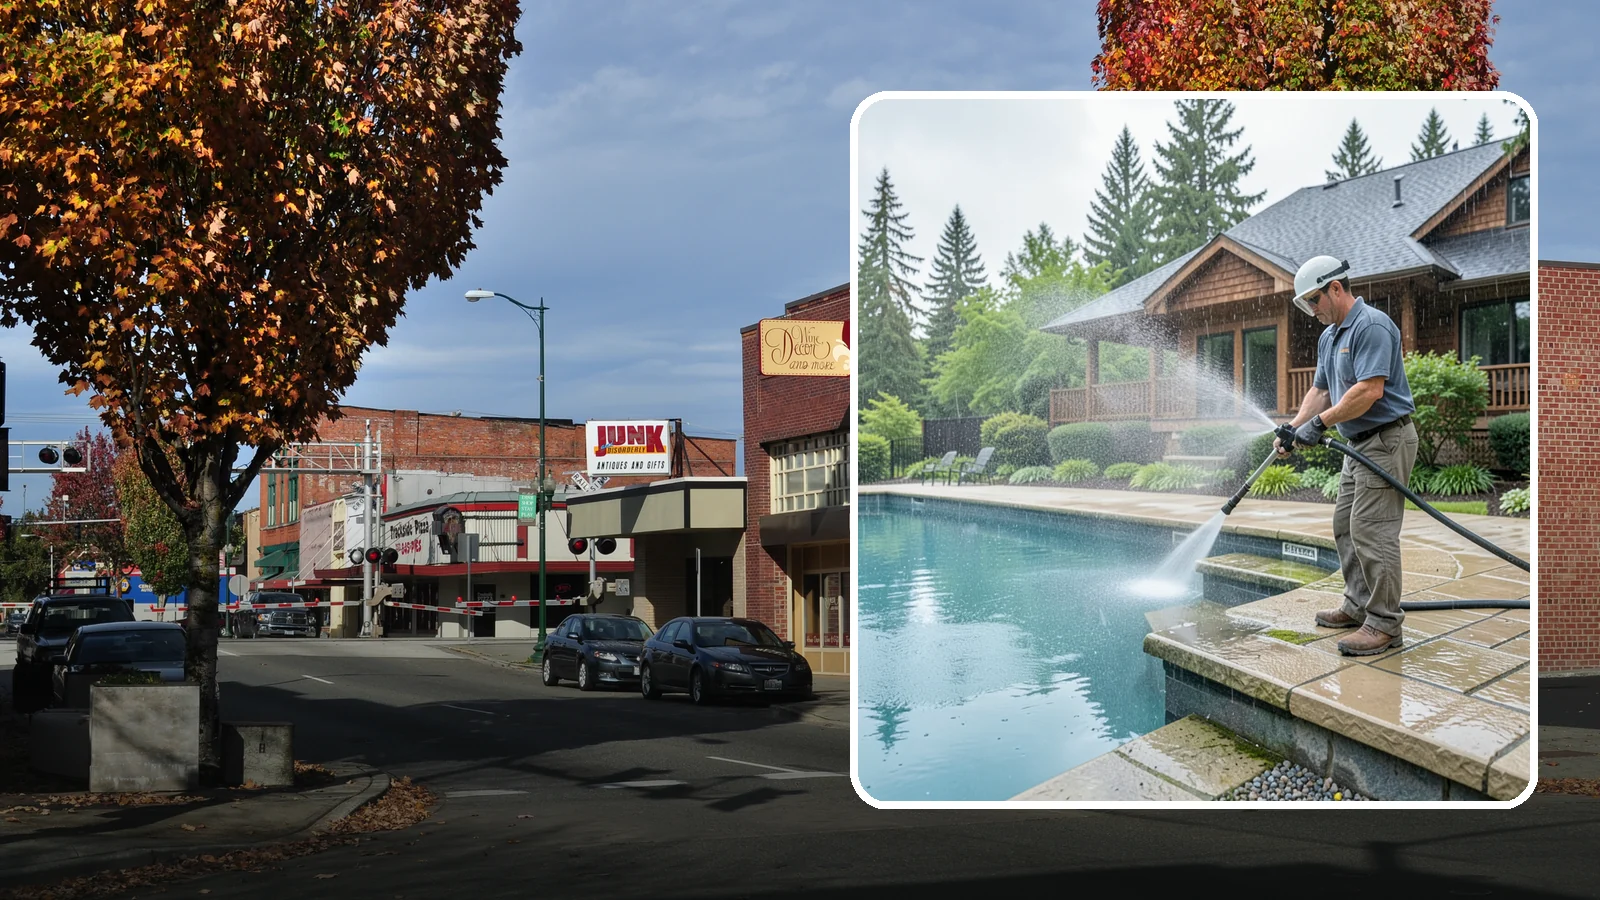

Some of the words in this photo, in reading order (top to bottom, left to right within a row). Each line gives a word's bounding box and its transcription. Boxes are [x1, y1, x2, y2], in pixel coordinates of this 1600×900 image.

[596, 425, 665, 457] JUNK
[607, 446, 646, 454] DISORDERLY
[597, 461, 628, 470] ANTIQUES
[631, 461, 643, 469] AND
[647, 460, 665, 469] GIFTS
[390, 521, 413, 540] Trackside
[414, 519, 429, 535] Pizza
